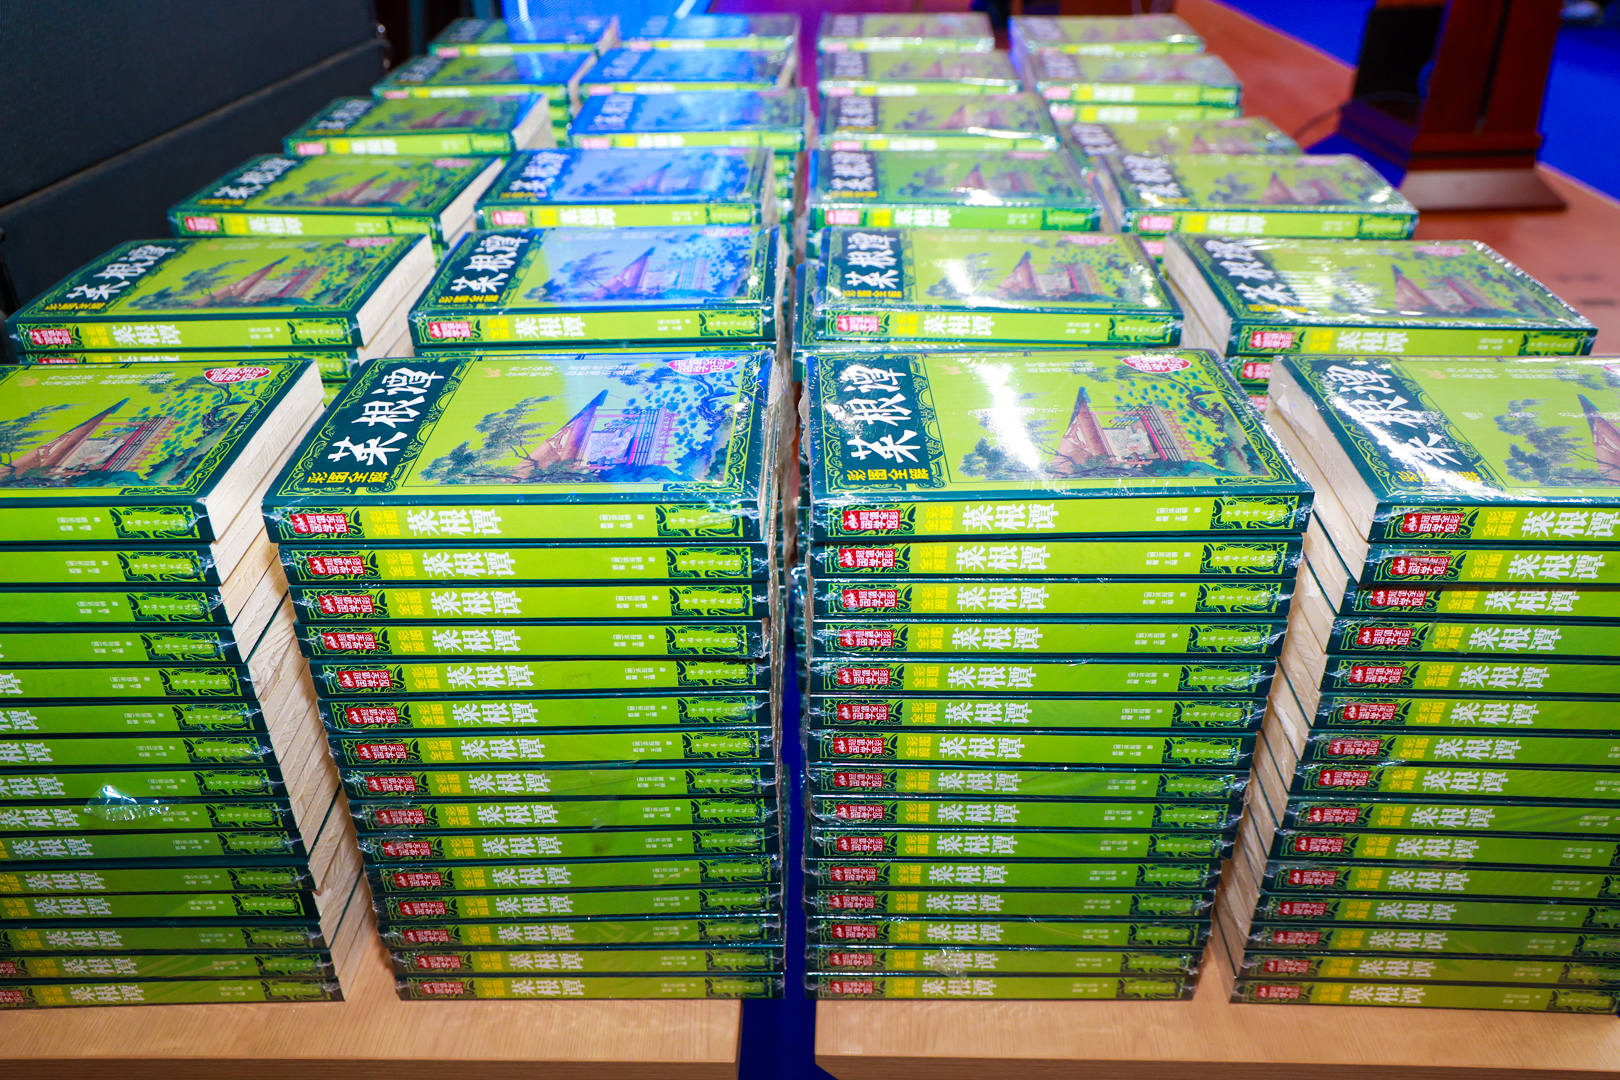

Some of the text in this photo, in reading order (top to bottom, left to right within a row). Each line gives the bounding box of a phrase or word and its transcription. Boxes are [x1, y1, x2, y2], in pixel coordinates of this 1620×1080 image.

[451, 235, 528, 293] 菜根谭
[846, 232, 899, 290] 菜根谭
[66, 245, 177, 301] 菜根谭
[112, 324, 182, 346] 菜根谭
[515, 316, 586, 338] 菜根谭
[923, 315, 995, 337] 菜根谭
[328, 366, 446, 466] 菜根谭
[844, 365, 922, 463] 菜根谭
[847, 469, 930, 481] 彩图全解
[407, 509, 502, 536] 菜根谭
[962, 503, 1059, 532] 菜根谭
[1521, 511, 1620, 538] 菜根谭
[423, 552, 516, 577] 菜根谭
[956, 545, 1050, 571] 菜根谭
[1507, 554, 1605, 580] 菜根谭
[431, 591, 522, 616] 菜根谭
[957, 586, 1049, 611] 菜根谭
[1484, 588, 1580, 613] 菜根谭
[432, 629, 521, 653] 菜根谭
[952, 627, 1043, 650] 菜根谭
[1468, 628, 1562, 651] 菜根谭
[447, 665, 534, 689] 菜根谭
[947, 666, 1036, 689] 菜根谭
[1458, 666, 1550, 689] 菜根谭
[453, 703, 538, 725] 菜根谭
[945, 699, 1032, 724] 菜根谭
[1450, 703, 1539, 725] 菜根谭
[0, 743, 53, 762] 根谭
[461, 738, 545, 760] 菜根谭
[939, 737, 1025, 759] 菜根谭
[1434, 739, 1521, 760] 菜根谭
[0, 777, 65, 797] 根谭
[469, 770, 551, 793] 菜根谭
[938, 770, 1022, 792] 菜根谭
[1422, 770, 1508, 793] 菜根谭
[477, 804, 559, 825] 菜根谭
[937, 804, 1020, 823] 菜根谭
[1410, 807, 1495, 828] 菜根谭
[13, 838, 93, 858] 菜根谭
[482, 834, 562, 856] 菜根谭
[937, 835, 1018, 854] 菜根谭
[1395, 838, 1479, 858] 菜根谭
[25, 873, 105, 890] 菜根谭
[492, 867, 571, 887] 菜根谭
[929, 865, 1008, 884] 菜根谭
[1387, 871, 1470, 891] 菜根谭
[34, 898, 112, 916] 菜根谭
[496, 896, 573, 917] 菜根谭
[926, 894, 1004, 912] 菜根谭
[1376, 903, 1457, 921] 菜根谭
[46, 931, 122, 948] 菜根谭
[498, 925, 574, 943] 菜根谭
[927, 924, 1004, 942] 菜根谭
[1369, 931, 1448, 949] 菜根谭
[62, 958, 137, 975] 菜根谭
[509, 953, 584, 970] 菜根谭
[1358, 960, 1436, 977] 菜根谭
[70, 985, 144, 1002] 菜根谭
[511, 979, 585, 996] 菜根谭
[924, 979, 997, 996] 菜根谭
[1349, 986, 1425, 1003] 菜根谭
